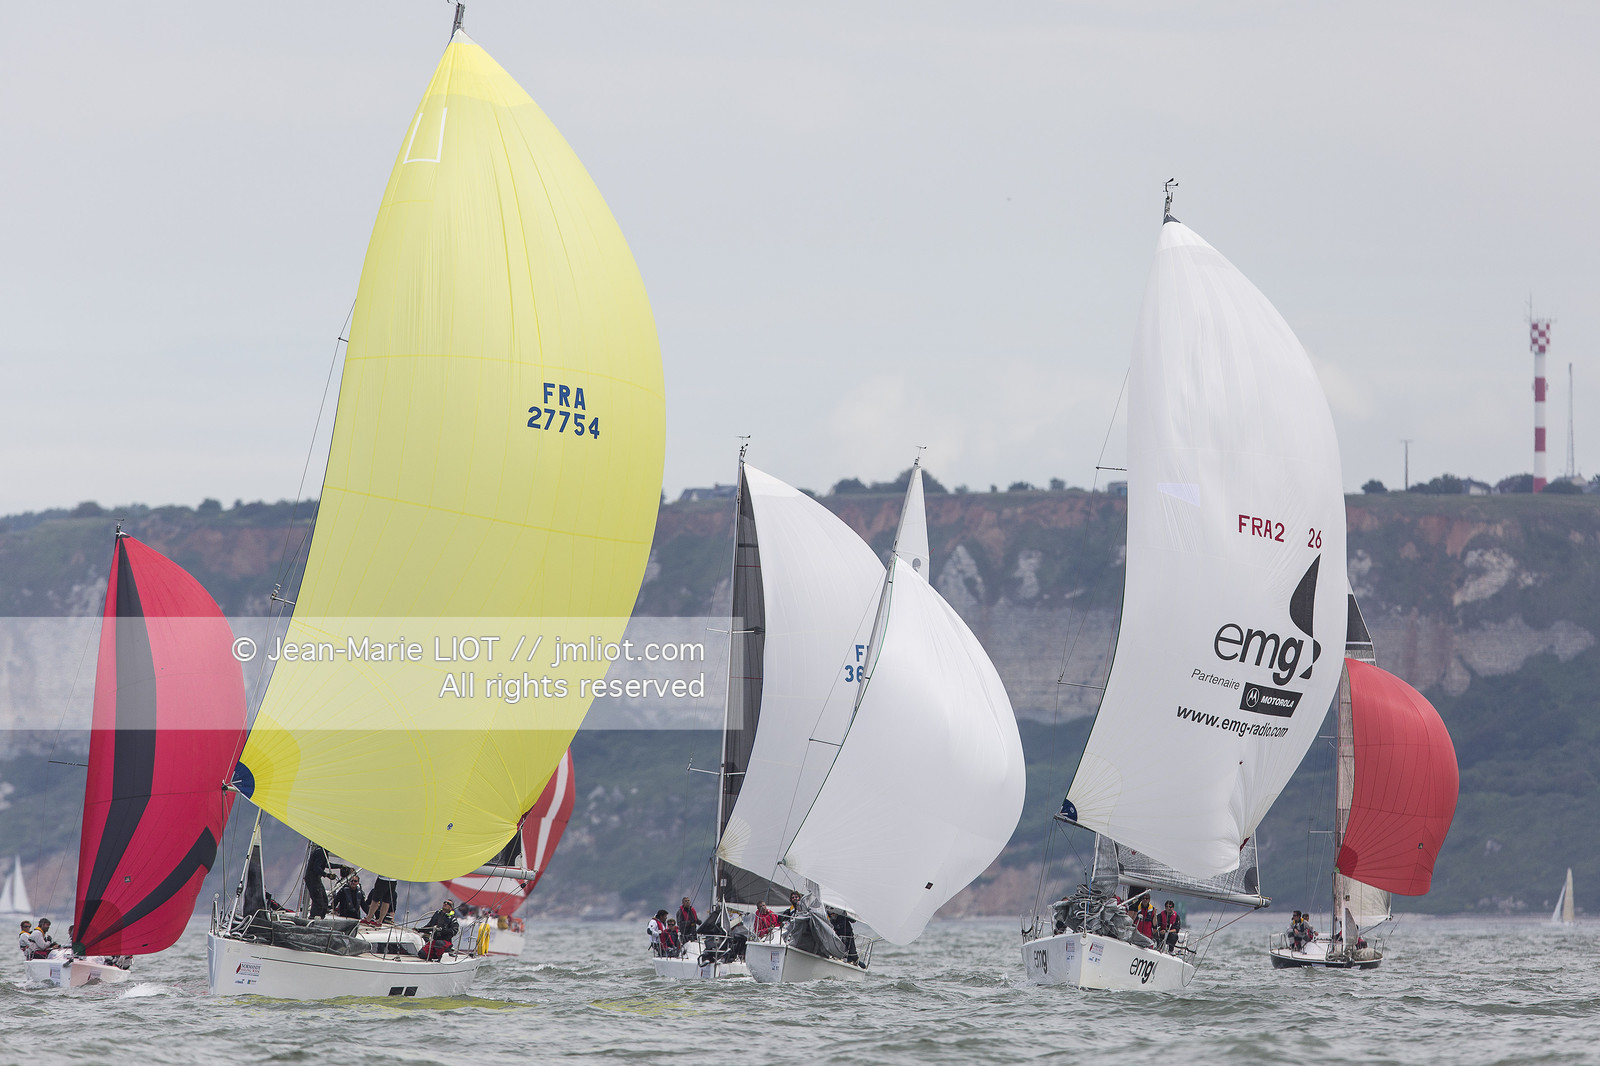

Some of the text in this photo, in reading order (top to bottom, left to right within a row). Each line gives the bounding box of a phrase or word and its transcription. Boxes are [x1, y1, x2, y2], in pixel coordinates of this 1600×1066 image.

[543, 382, 586, 410] FRA
[527, 406, 600, 439] 27754
[1307, 527, 1322, 548] 26
[1214, 623, 1304, 686] emg
[1191, 668, 1240, 690] Partenaire
[1260, 695, 1295, 708] MOTOROLA
[1176, 705, 1289, 738] www.emg-radio.com
[1130, 957, 1155, 984] emg
